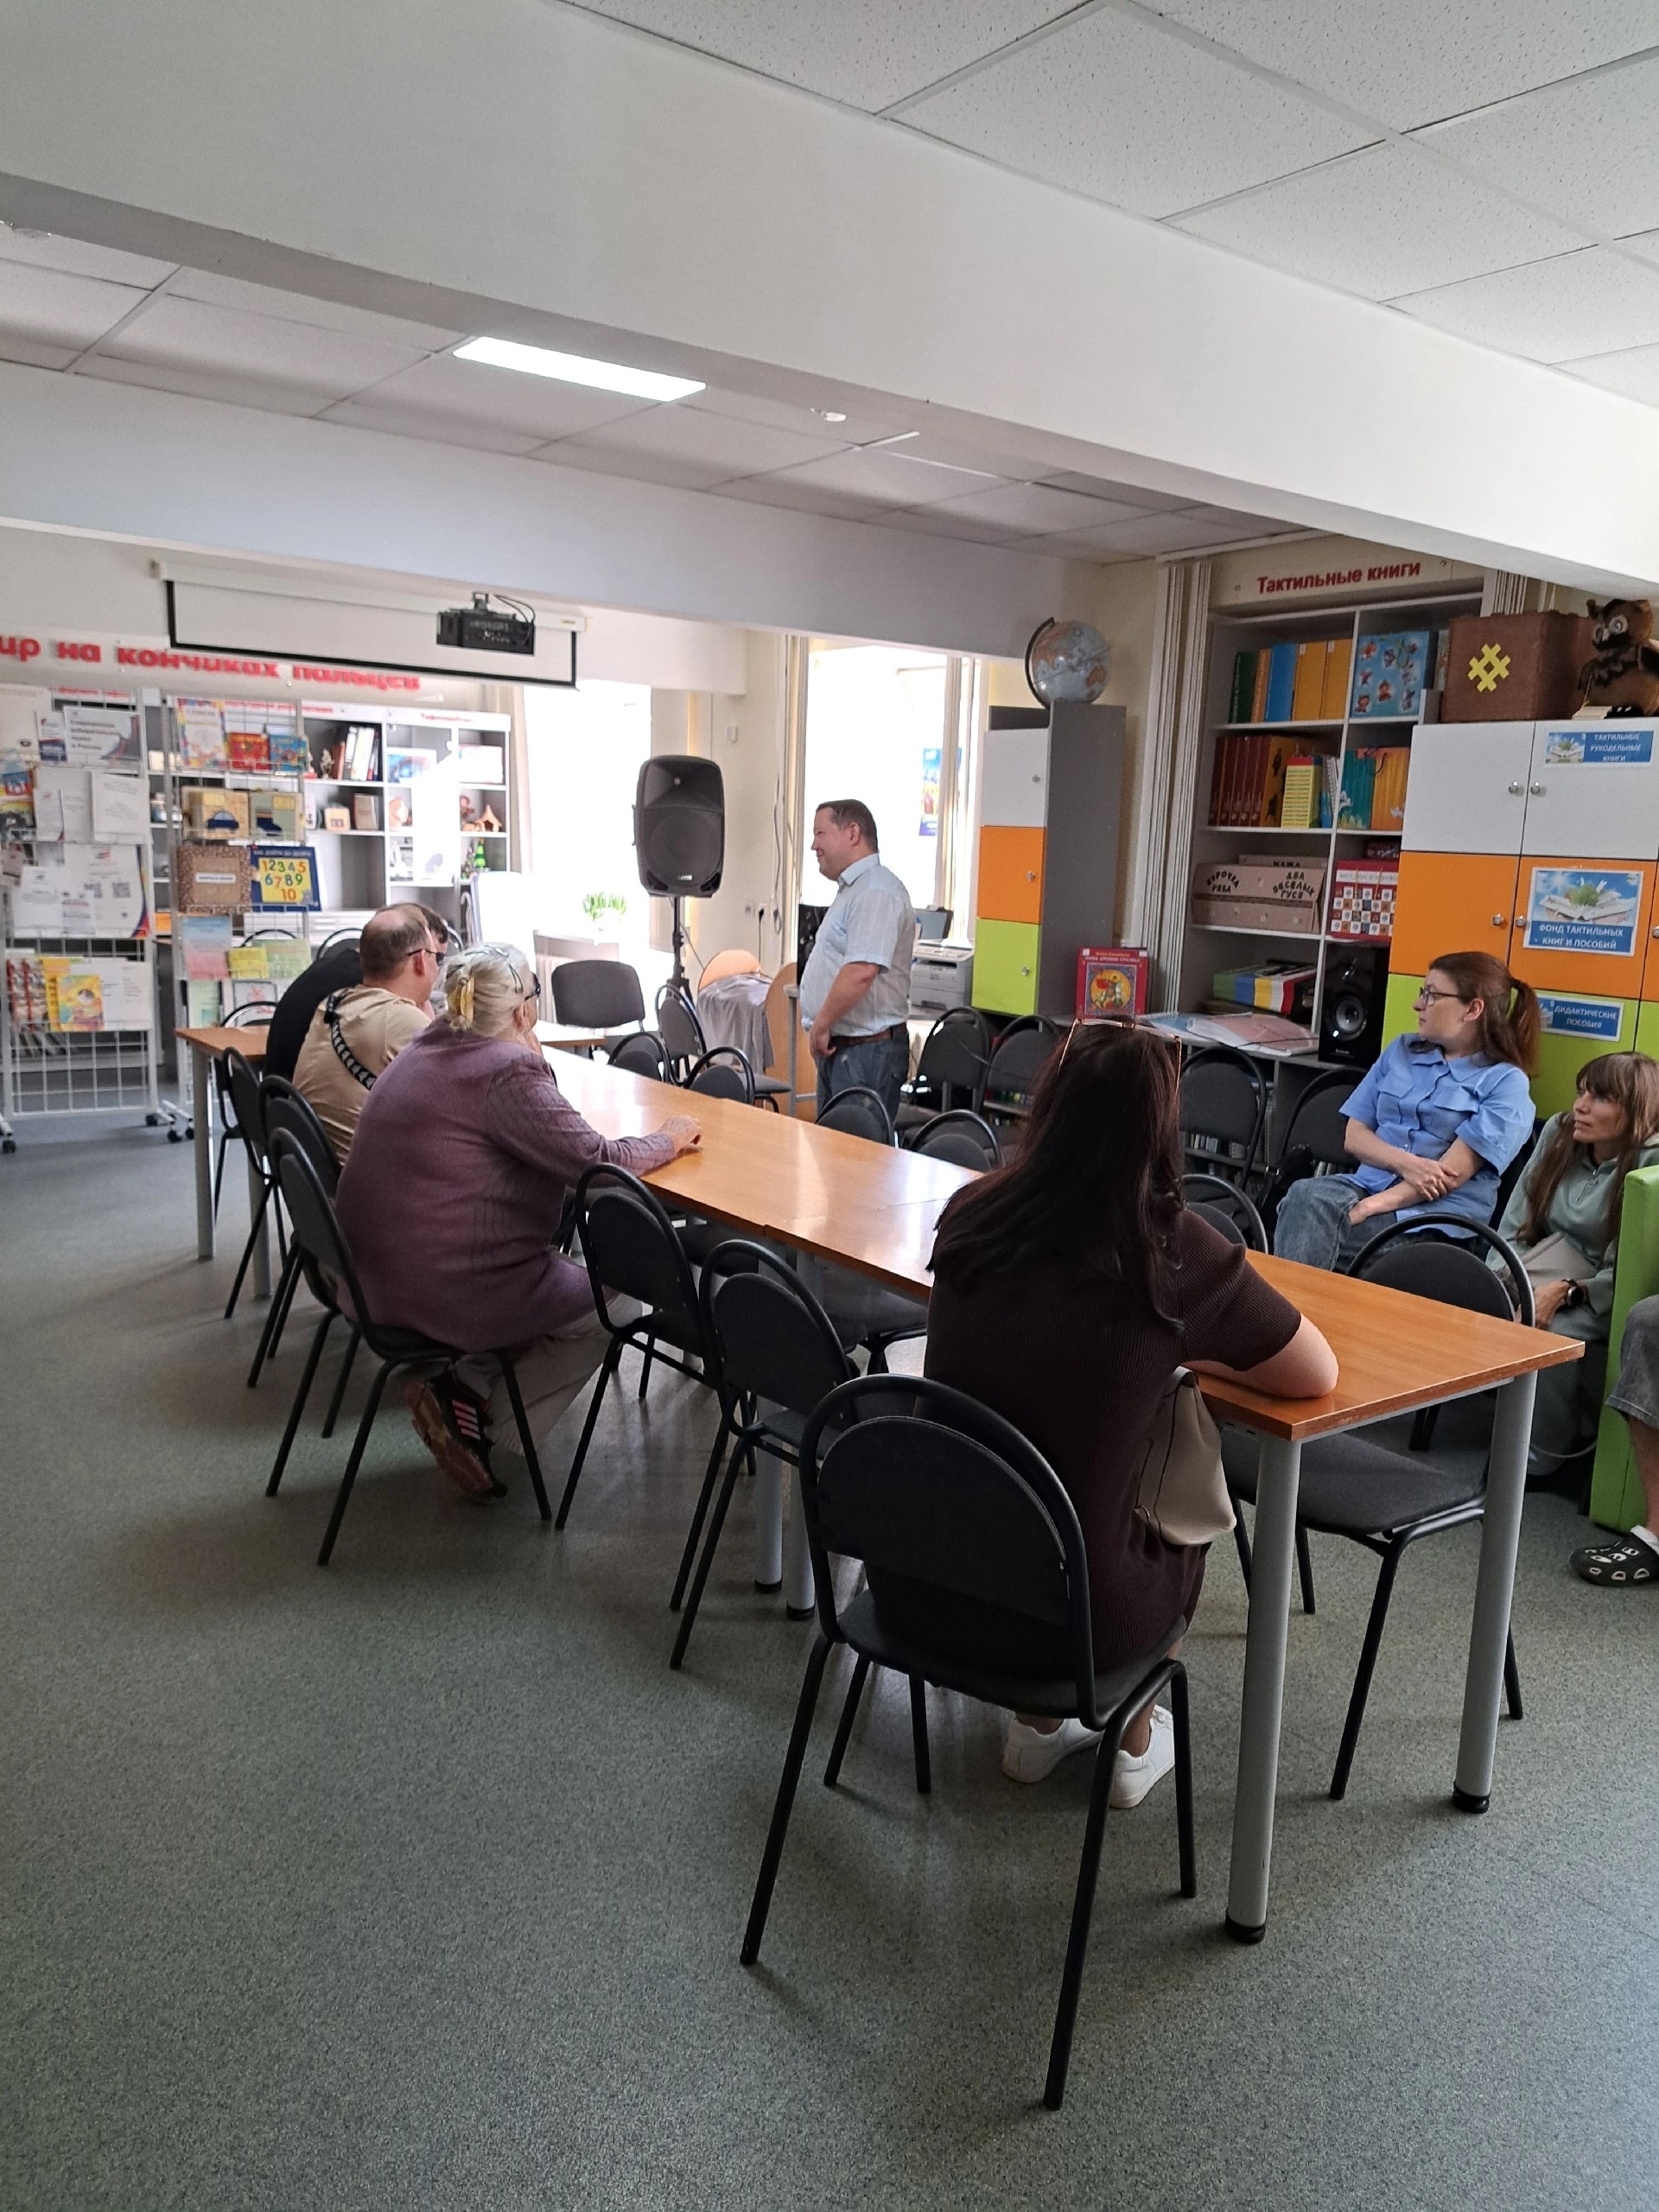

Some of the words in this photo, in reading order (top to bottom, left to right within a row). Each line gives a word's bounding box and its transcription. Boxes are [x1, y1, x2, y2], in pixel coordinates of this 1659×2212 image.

[1257, 569, 1363, 594] Тактильные
[1367, 563, 1421, 582] книги
[56, 642, 102, 663] на
[118, 647, 280, 677] кончиках
[262, 861, 268, 872] 1
[269, 860, 276, 872] 2
[277, 861, 285, 873] 3
[288, 861, 296, 872] 4
[298, 861, 306, 874] 5
[265, 874, 273, 886] 6
[274, 876, 283, 889] 7
[285, 874, 293, 887] 8
[295, 873, 302, 886] 9
[1206, 871, 1239, 888] КУРОЧКА
[1286, 872, 1305, 880] ДВА
[281, 888, 297, 901] 10
[1211, 884, 1231, 893] РЯБА
[1281, 890, 1303, 899] ГУСЯ
[1539, 924, 1565, 935] ФОНД
[1567, 925, 1624, 938] ТАКТИЛЬНЫХ
[1541, 937, 1564, 947] КНИГ
[1573, 939, 1617, 950] ПОСОБИЙ
[1554, 1005, 1617, 1020] ДИДАКТИЧЕСКИЕ
[1567, 1018, 1602, 1029] ПОСОБИЯ
